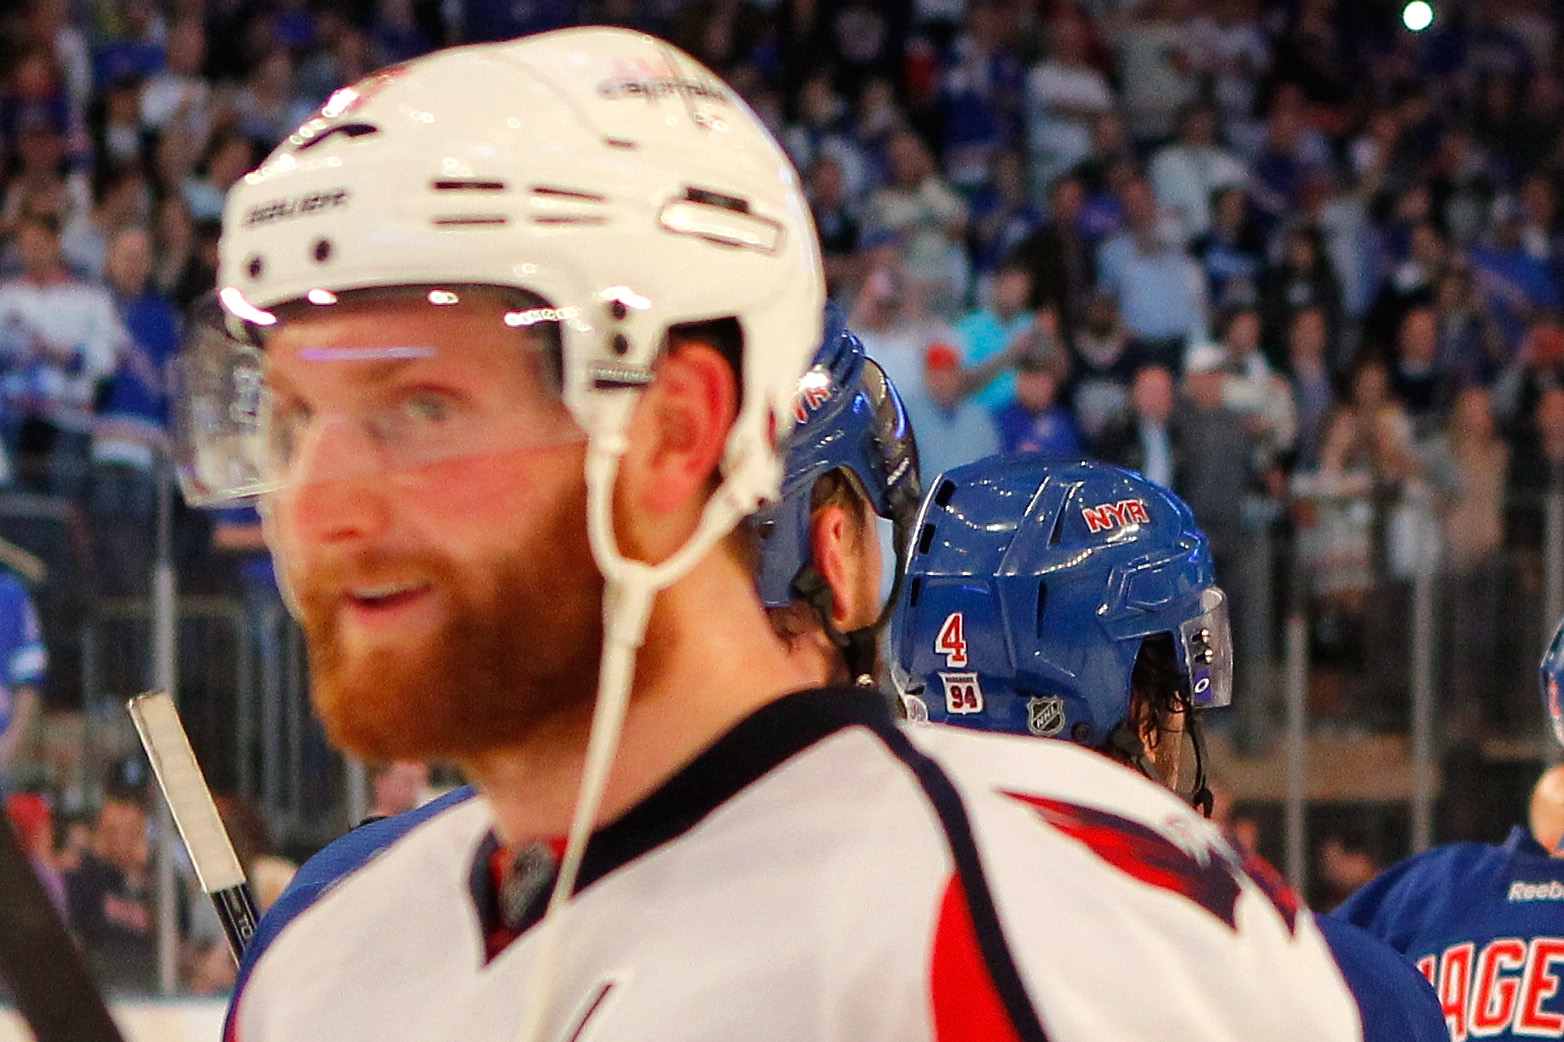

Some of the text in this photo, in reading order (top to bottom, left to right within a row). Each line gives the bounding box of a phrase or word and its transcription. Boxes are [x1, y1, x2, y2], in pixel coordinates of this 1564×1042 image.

[1082, 499, 1150, 533] NYR
[936, 612, 967, 668] 4
[950, 685, 978, 709] 94
